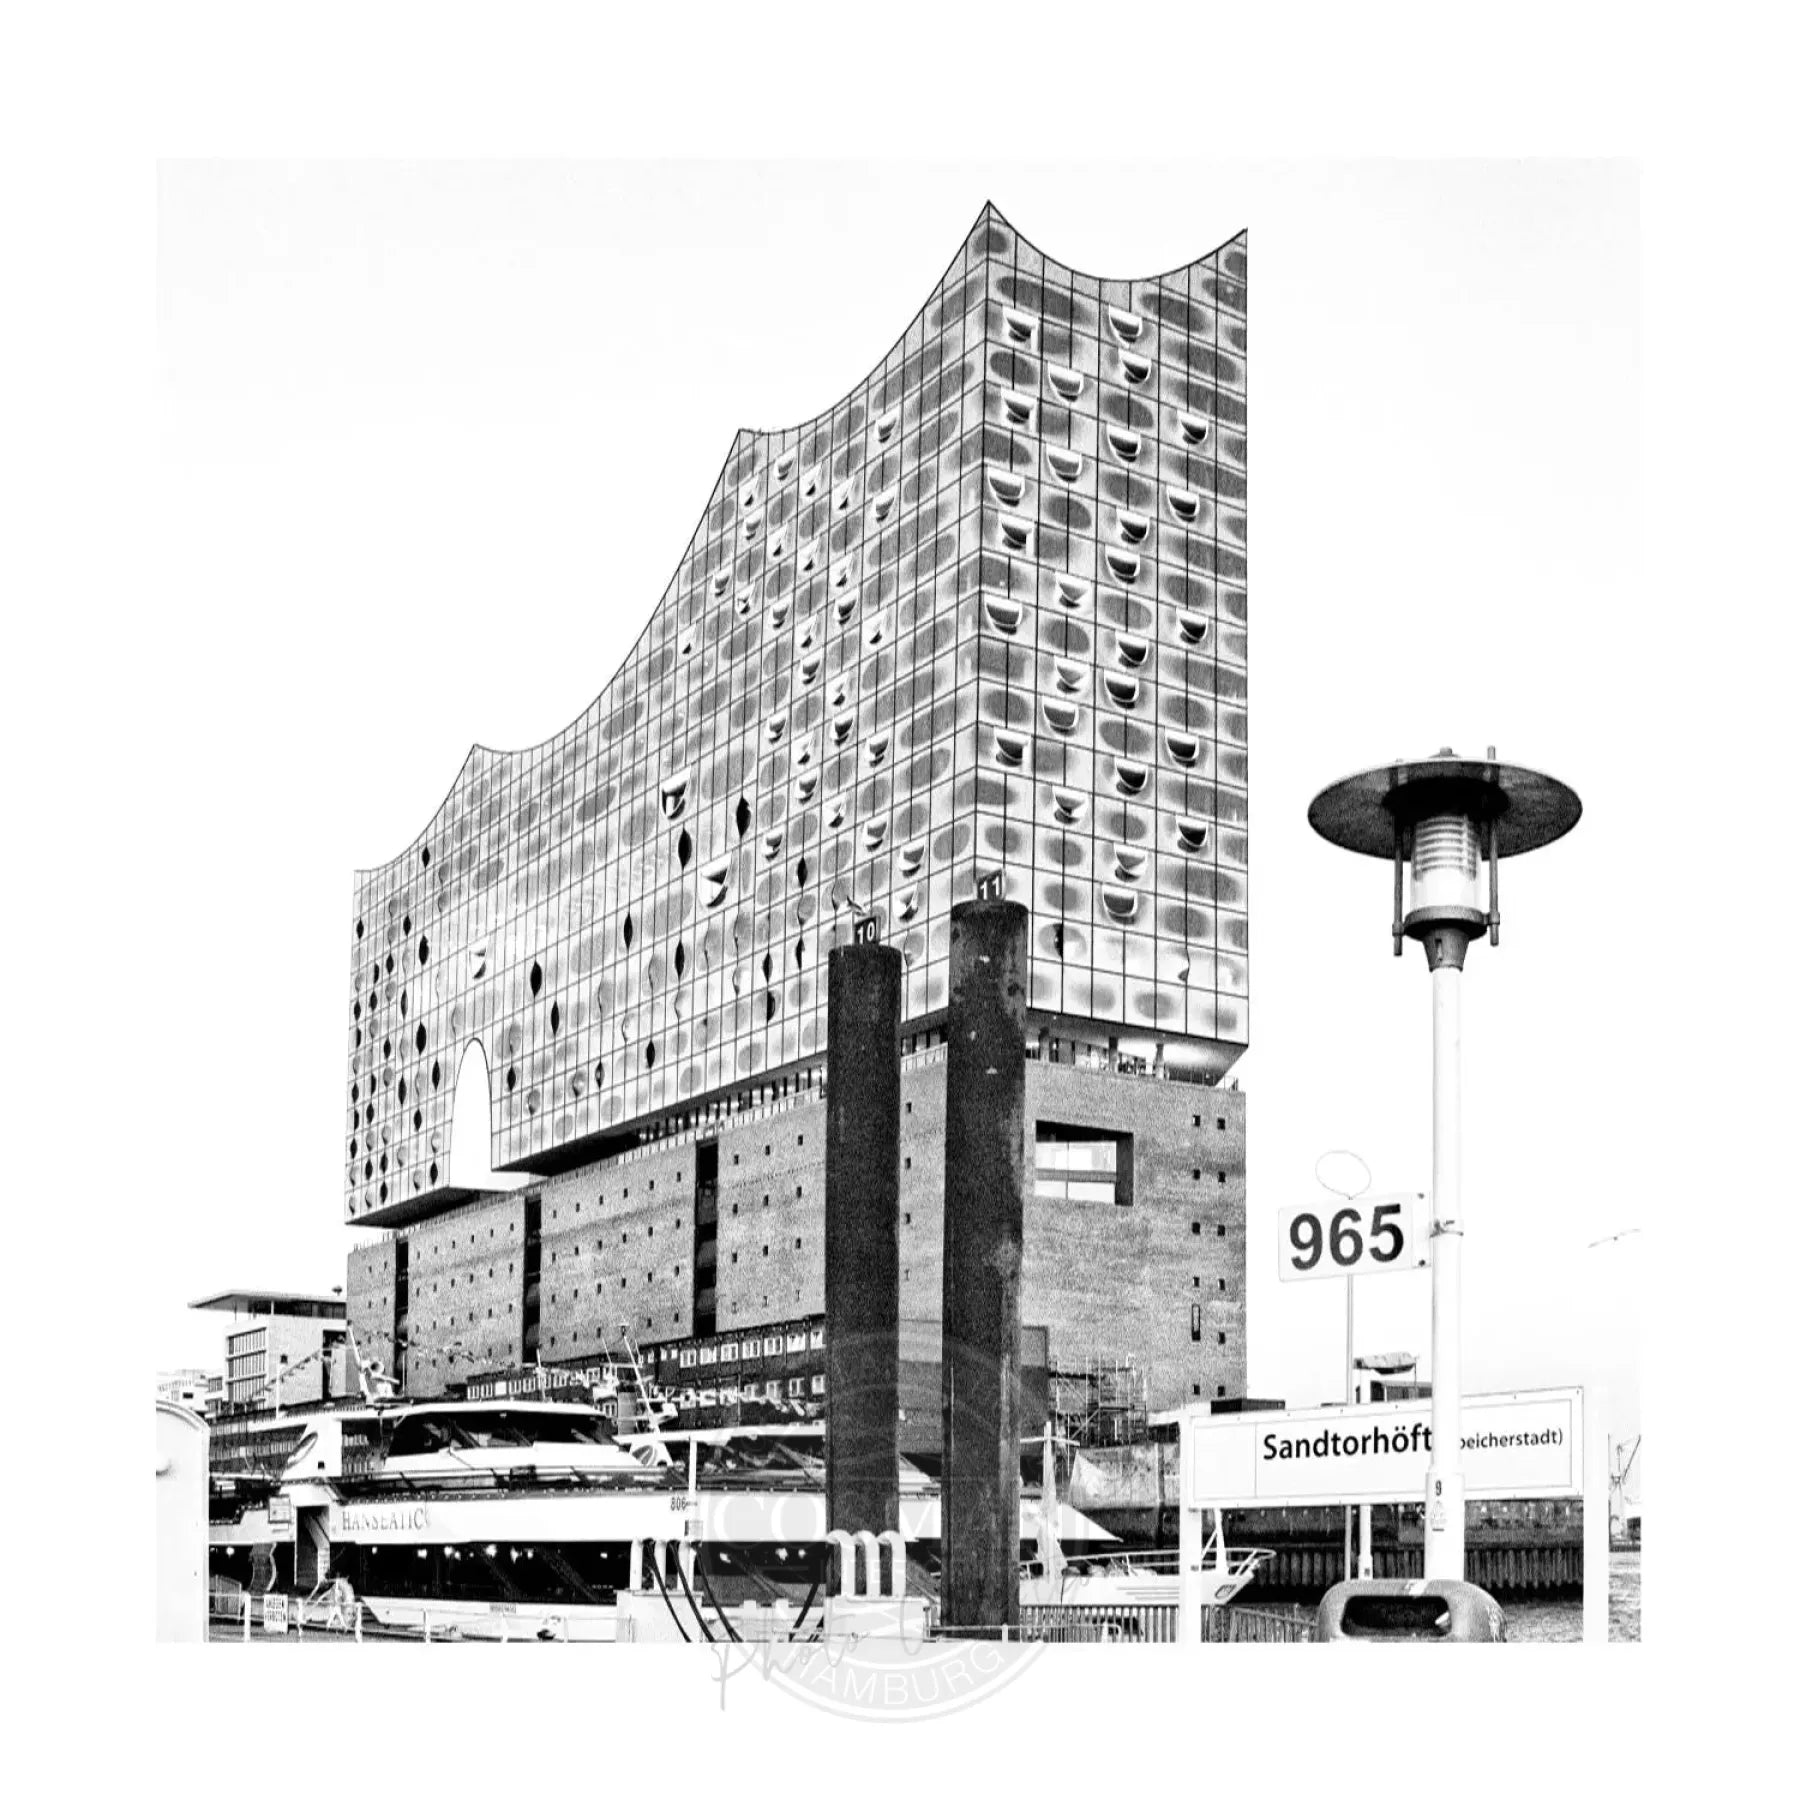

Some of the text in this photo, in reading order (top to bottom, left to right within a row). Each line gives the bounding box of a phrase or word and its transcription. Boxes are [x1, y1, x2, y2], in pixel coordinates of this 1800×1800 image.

[979, 876, 1001, 900] 11
[856, 922, 876, 945] 10
[1289, 1203, 1405, 1270] 965
[1263, 1422, 1564, 1460] Sandtorhöft eicherstadt)
